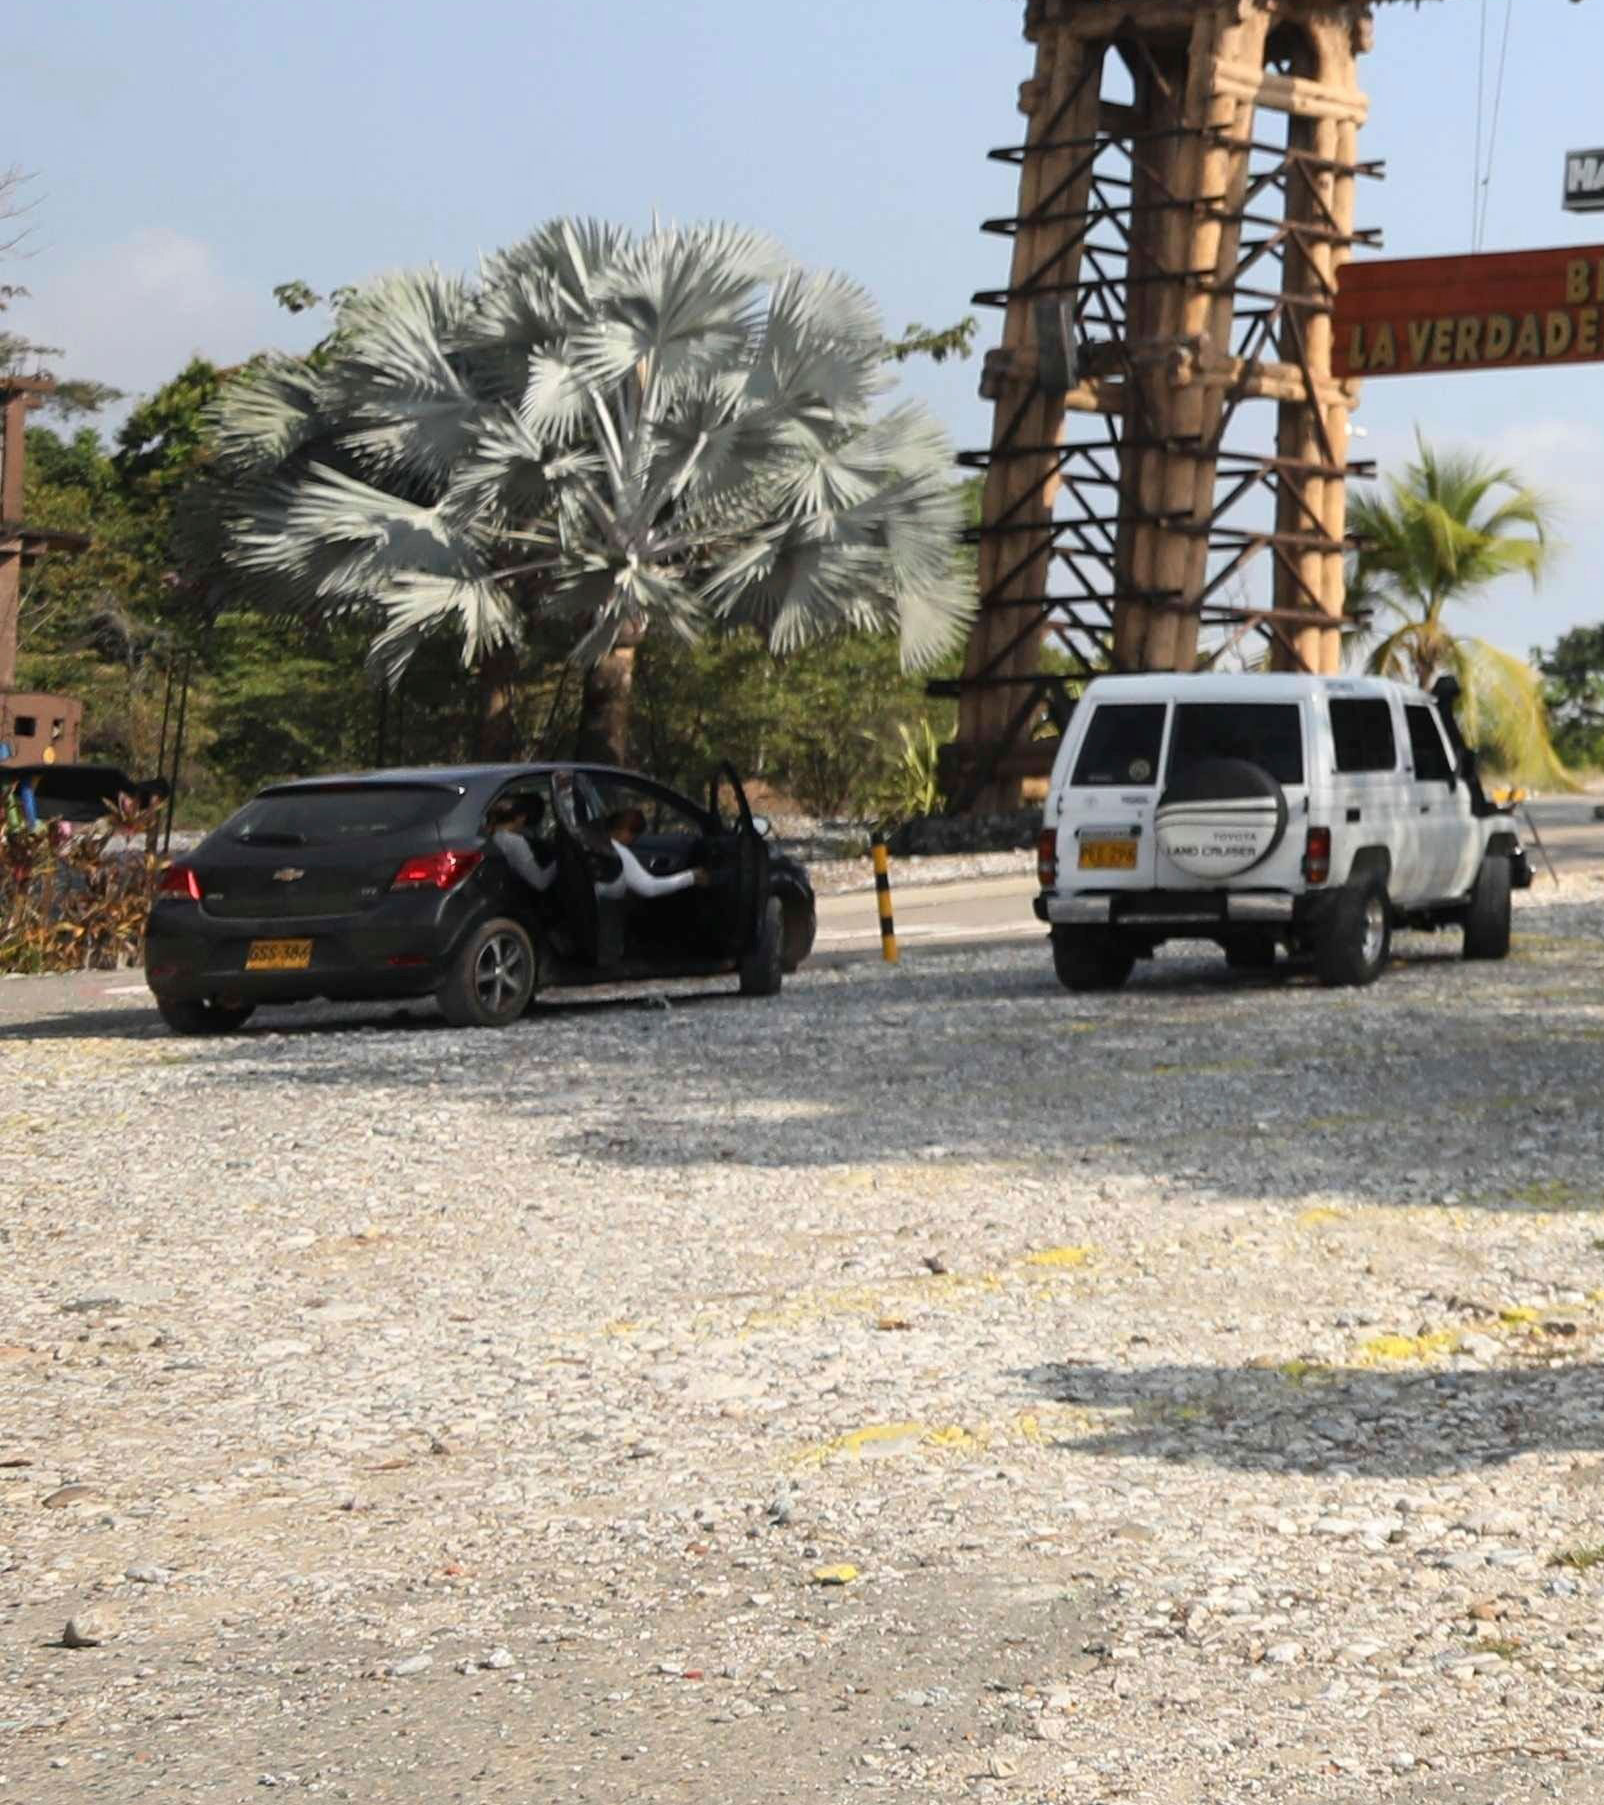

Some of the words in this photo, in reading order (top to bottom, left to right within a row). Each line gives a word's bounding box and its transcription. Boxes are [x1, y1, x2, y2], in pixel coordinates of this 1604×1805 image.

[1347, 322, 1398, 371] LA
[1213, 831, 1257, 842] TOYOTA
[1167, 844, 1199, 857] LAND
[1201, 843, 1257, 857] CRUISER
